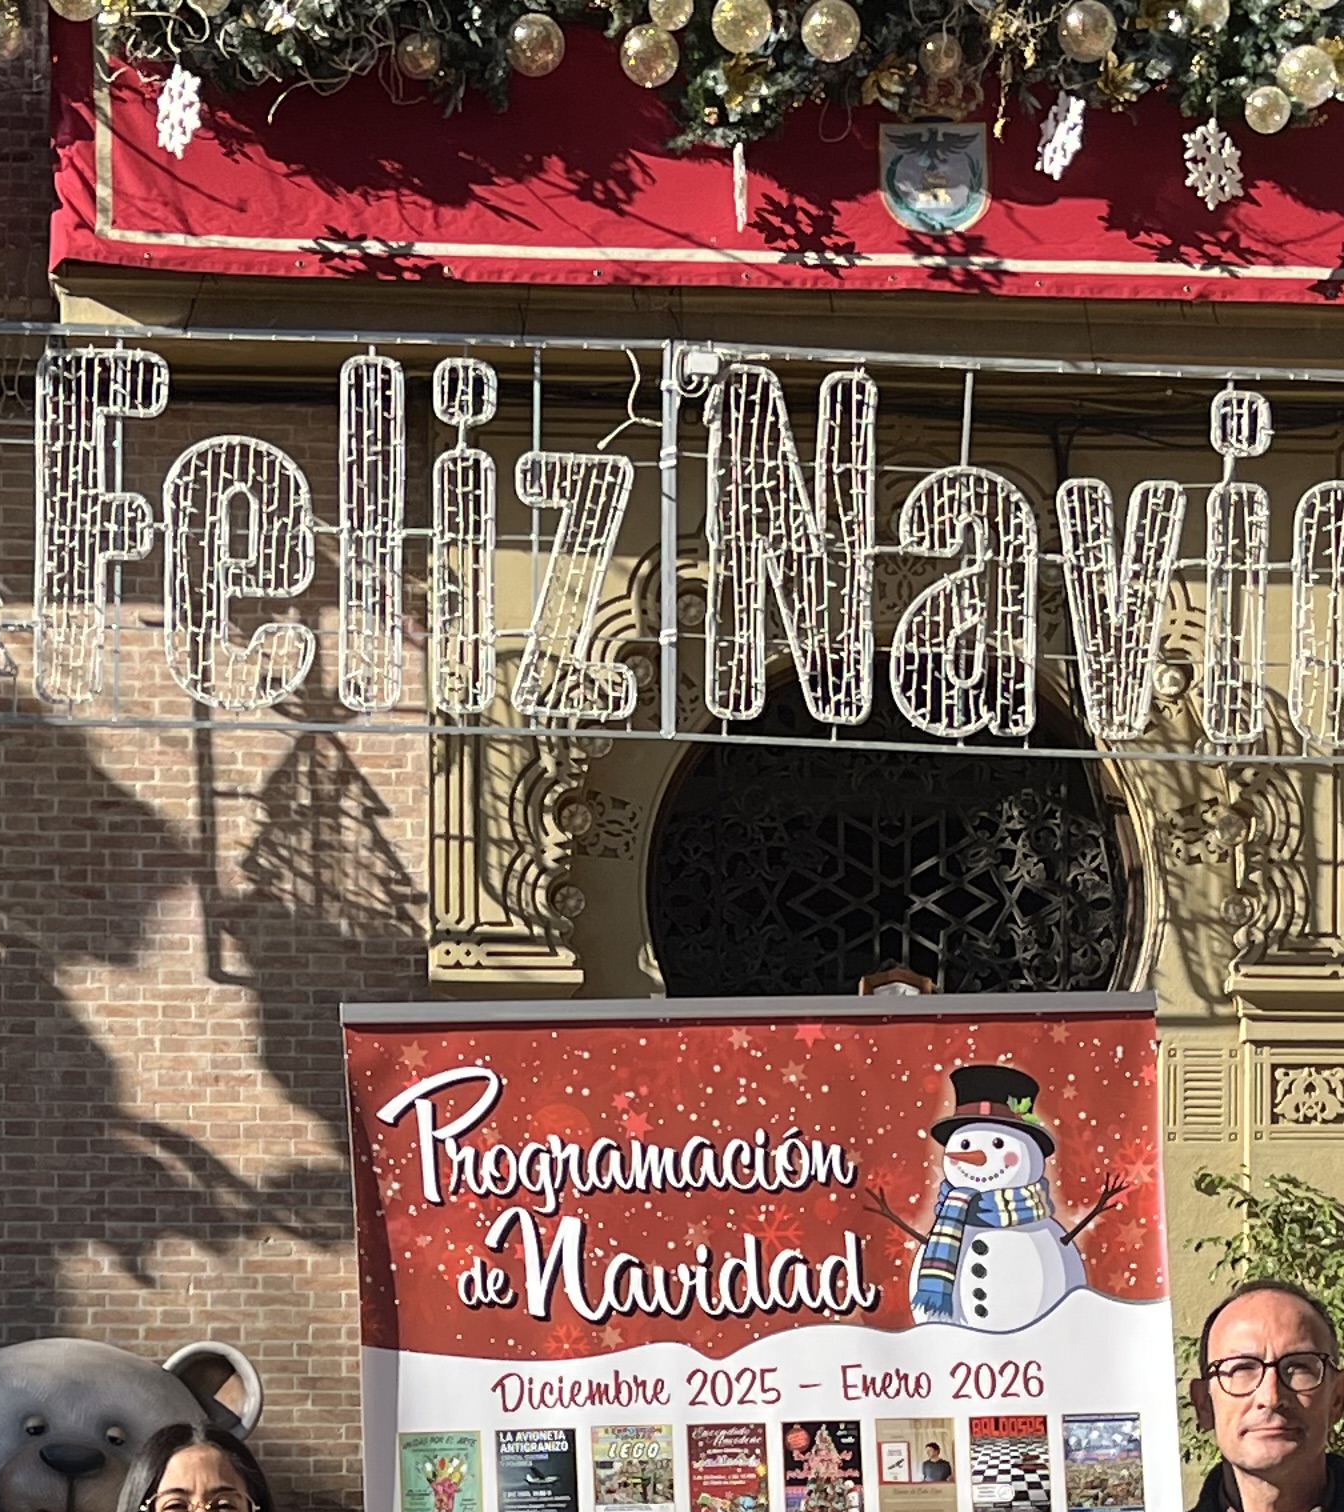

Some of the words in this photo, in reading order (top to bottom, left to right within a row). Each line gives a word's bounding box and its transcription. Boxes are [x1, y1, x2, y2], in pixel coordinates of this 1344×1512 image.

[34, 347, 637, 718] Feliz
[375, 1066, 859, 1213] Programación
[458, 1257, 515, 1308] de
[485, 1206, 877, 1321] Navidad
[491, 1369, 671, 1412] Diciembre
[685, 1366, 781, 1407] 2025
[841, 1363, 933, 1402] Enero
[950, 1360, 1045, 1400] 2026
[499, 1431, 513, 1443] LA
[515, 1430, 566, 1442] AVIONETA
[499, 1441, 569, 1453] ANTIGRANIZO
[607, 1441, 660, 1459] LEGO
